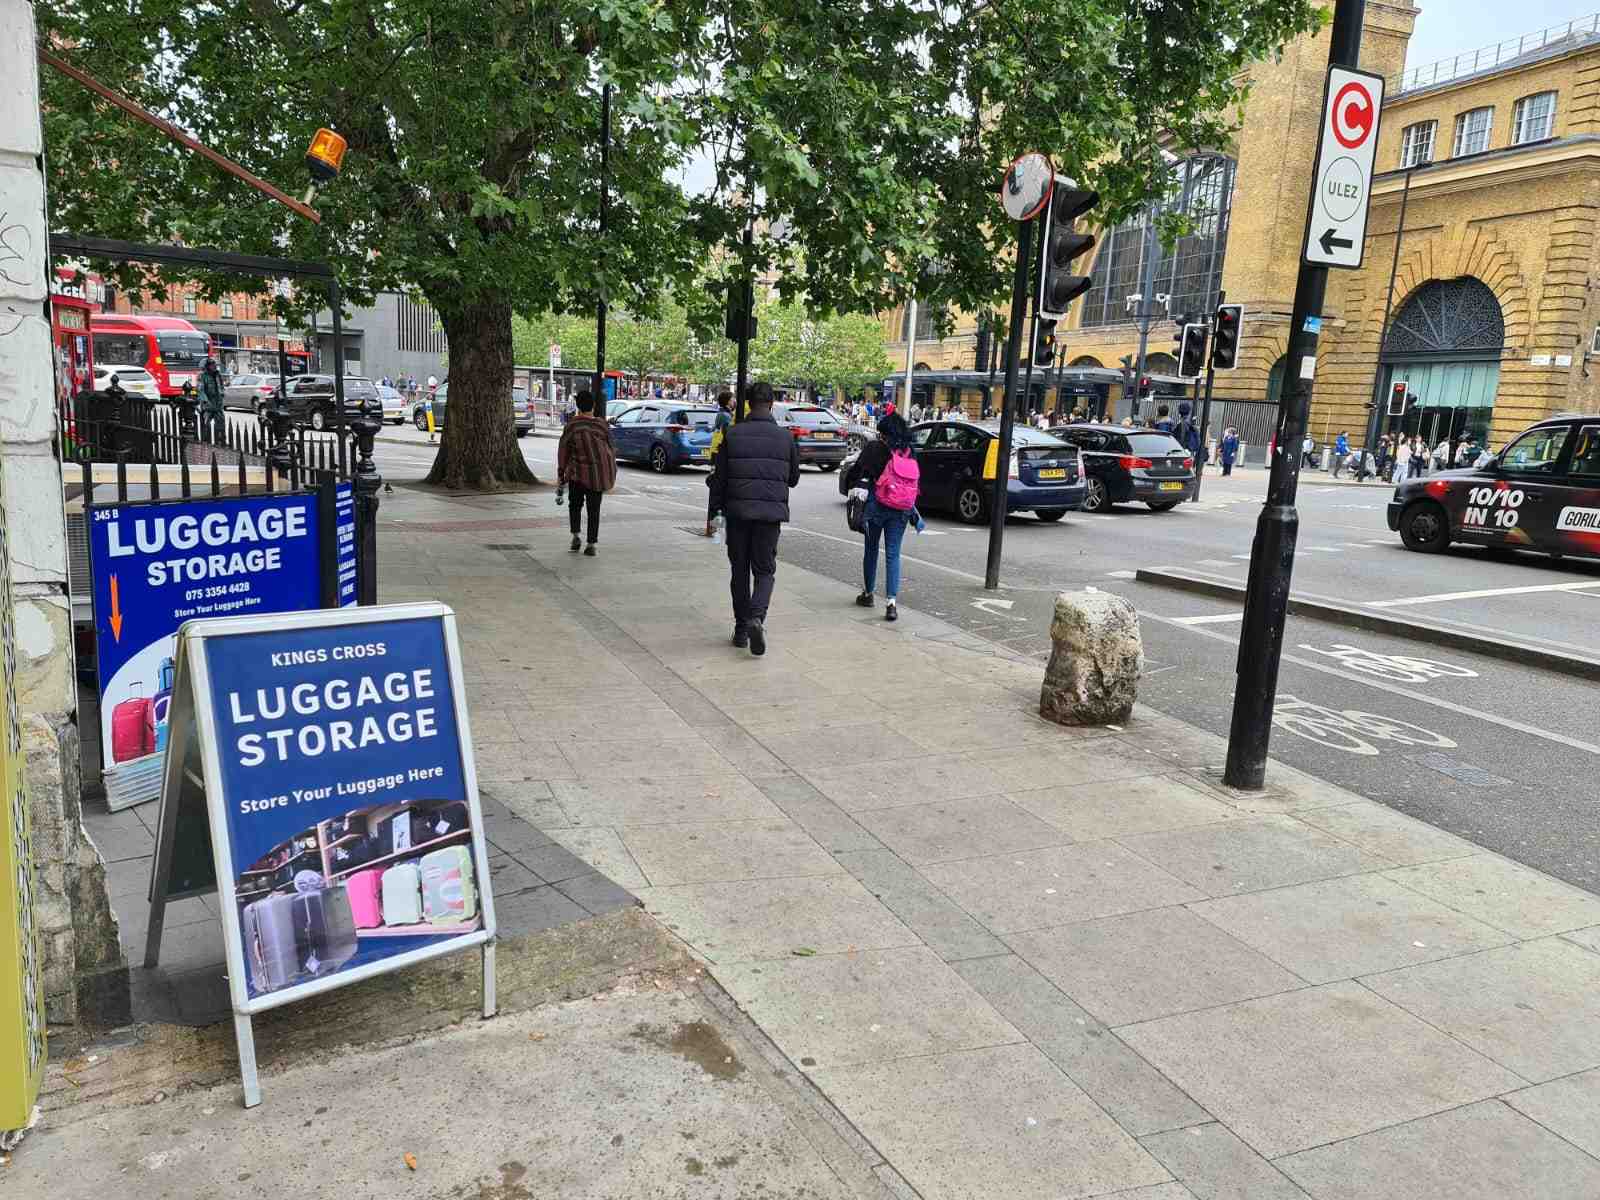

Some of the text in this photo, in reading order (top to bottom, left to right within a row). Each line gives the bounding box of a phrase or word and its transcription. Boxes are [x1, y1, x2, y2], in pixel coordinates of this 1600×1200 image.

[1328, 181, 1358, 199] ULEZ
[1468, 487, 1525, 508] 10/10
[94, 509, 119, 521] 345 B
[1463, 507, 1519, 528] IN 10
[107, 506, 308, 557] LUGGAGE
[147, 547, 281, 586] STORAGE
[185, 581, 251, 601] 075 3354 4428
[174, 596, 261, 618] Store Your Luggage Here
[271, 643, 387, 667] KINGS CROSS
[229, 668, 435, 724] LUGGAGE
[237, 708, 438, 767] STORAGE
[240, 766, 444, 814] Store Your Luggage Here
